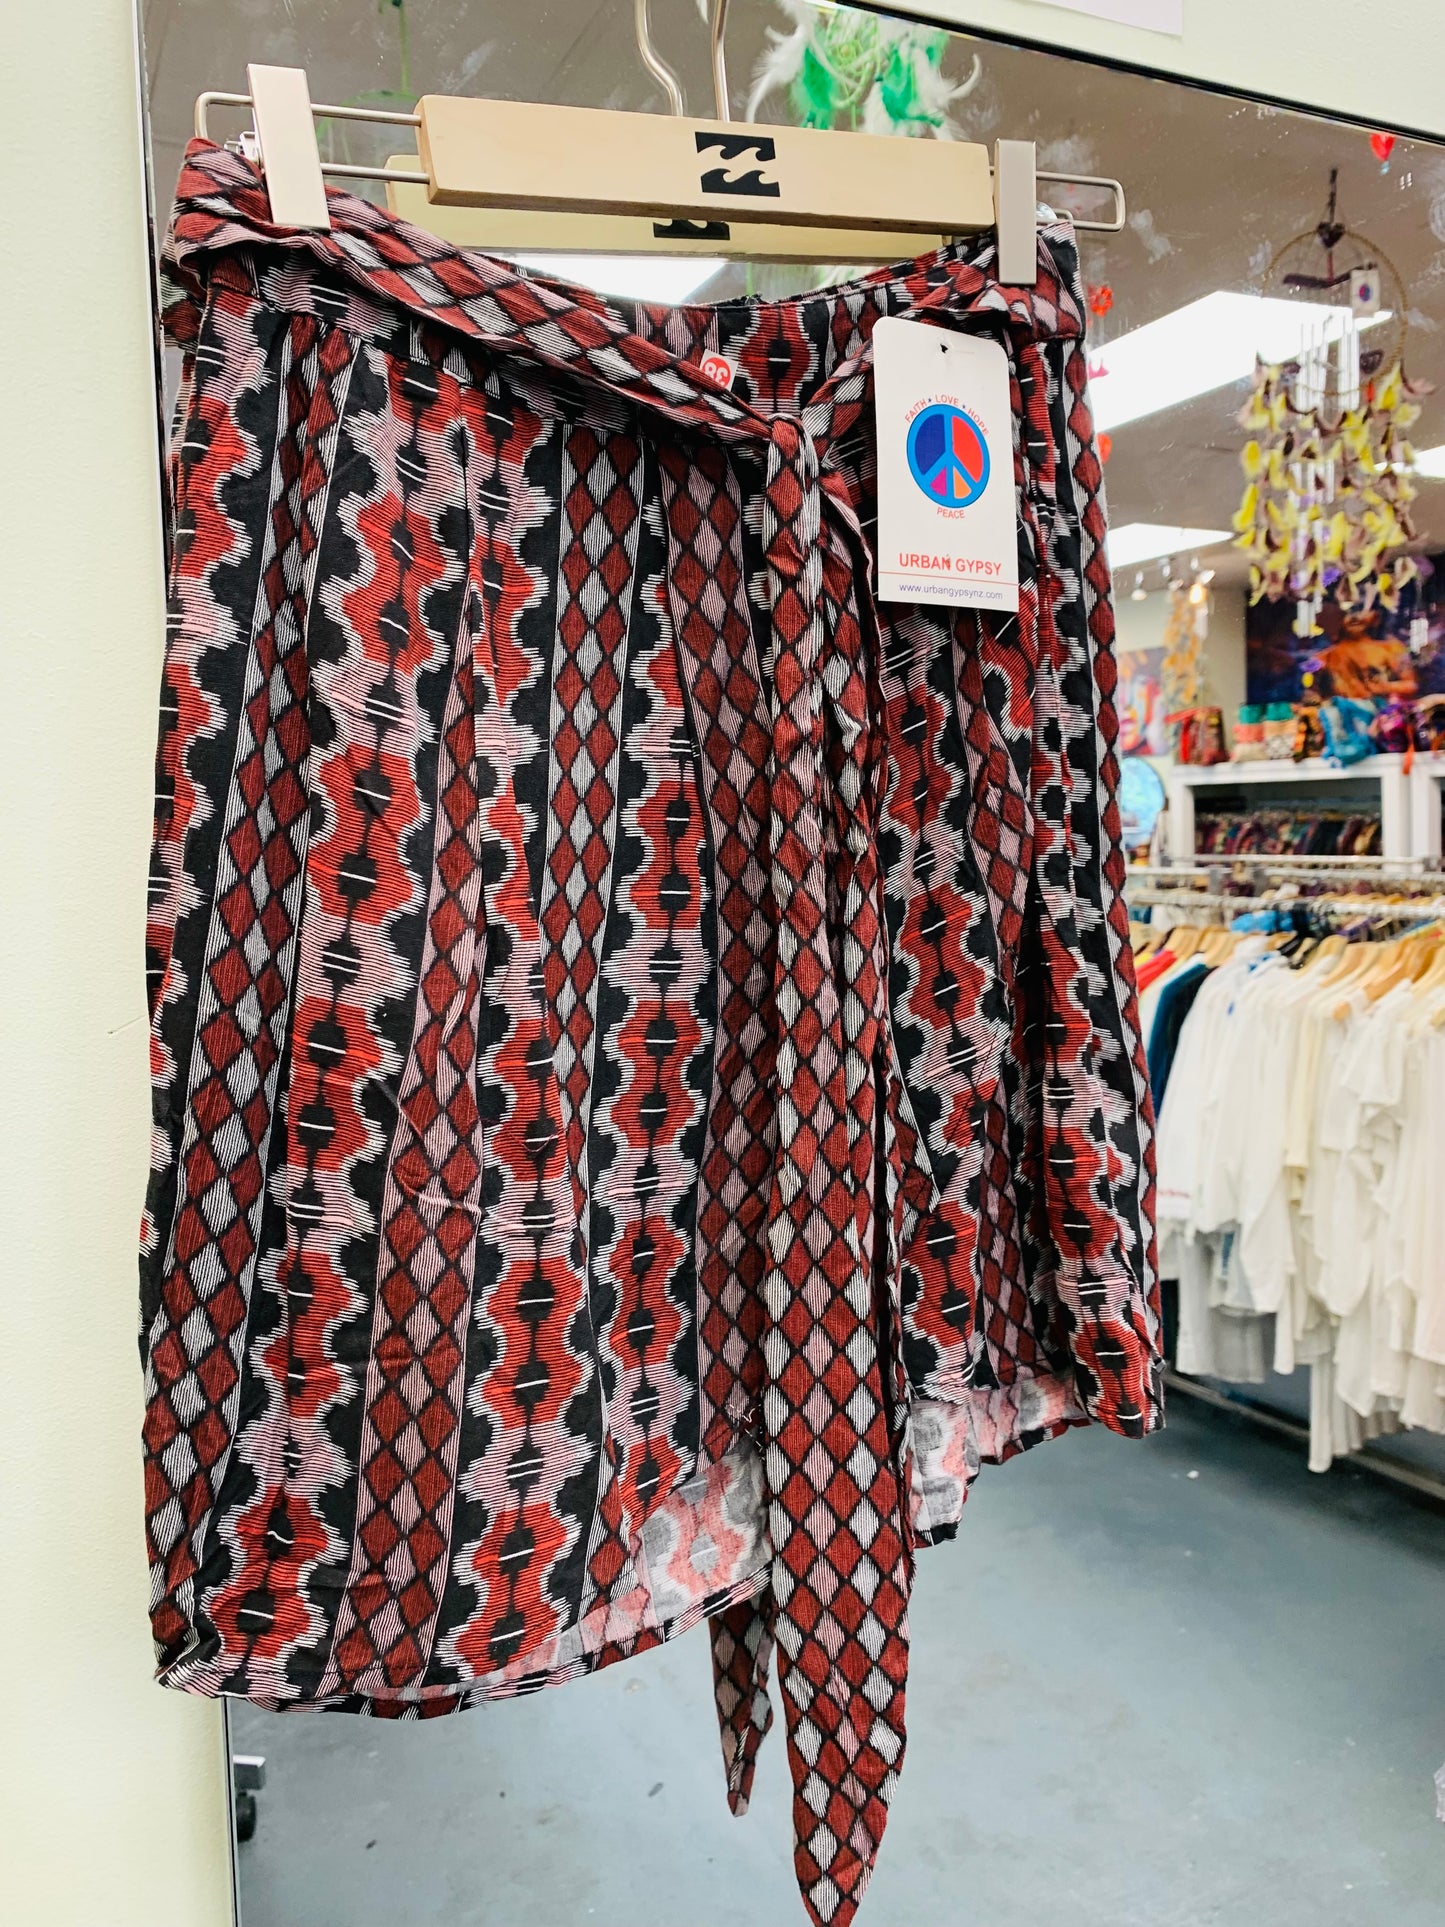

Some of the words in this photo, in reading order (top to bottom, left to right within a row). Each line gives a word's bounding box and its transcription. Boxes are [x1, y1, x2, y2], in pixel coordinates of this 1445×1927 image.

[904, 400, 928, 423] FAITH
[935, 394, 959, 405] LOVE
[967, 408, 989, 435] HOPE
[937, 507, 965, 519] PEACE
[899, 553, 951, 570] URBAN
[955, 558, 1002, 576] GYPSY
[899, 584, 1003, 600] www.urbangypsynz.com
